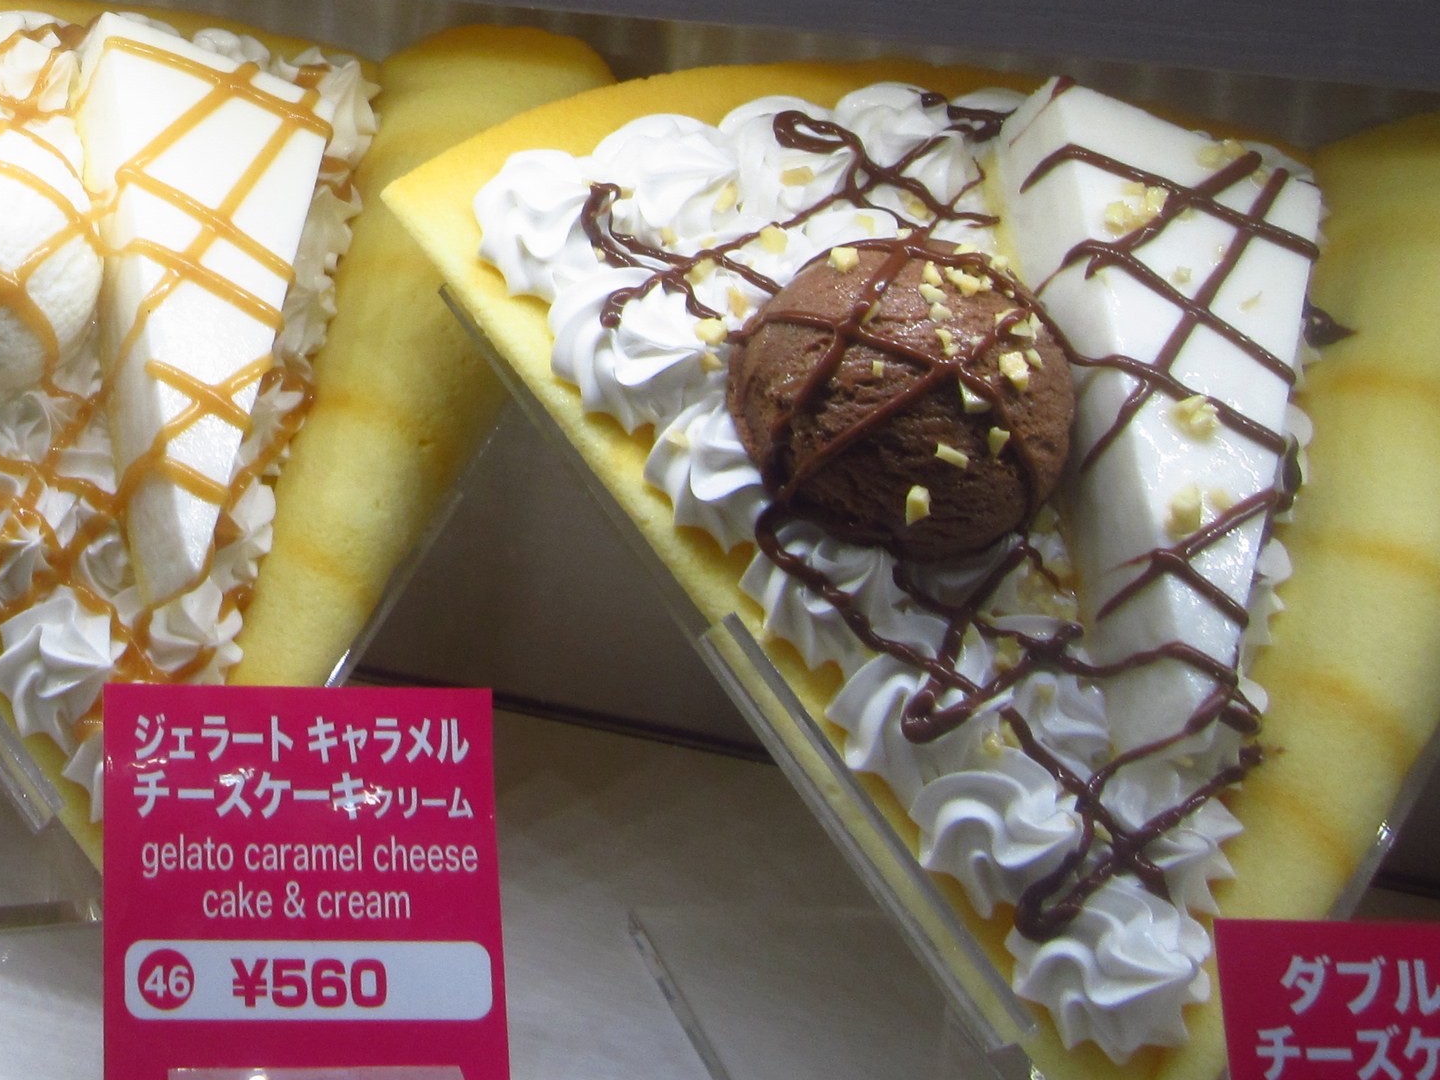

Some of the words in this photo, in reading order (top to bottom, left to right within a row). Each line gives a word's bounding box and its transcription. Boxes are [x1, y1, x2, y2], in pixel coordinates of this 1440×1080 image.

[134, 714, 294, 763] ジェラート
[307, 715, 470, 764] キャラメル
[133, 767, 474, 819] チーズケーキクリーム
[141, 834, 234, 878] gelato
[244, 835, 363, 872] caramel
[373, 835, 478, 872] cheese
[202, 882, 273, 919] cake
[283, 881, 306, 919] &
[317, 888, 411, 919] cream
[144, 965, 191, 998] 46
[230, 957, 388, 1009] ¥560
[1280, 954, 1440, 1016] ダブル
